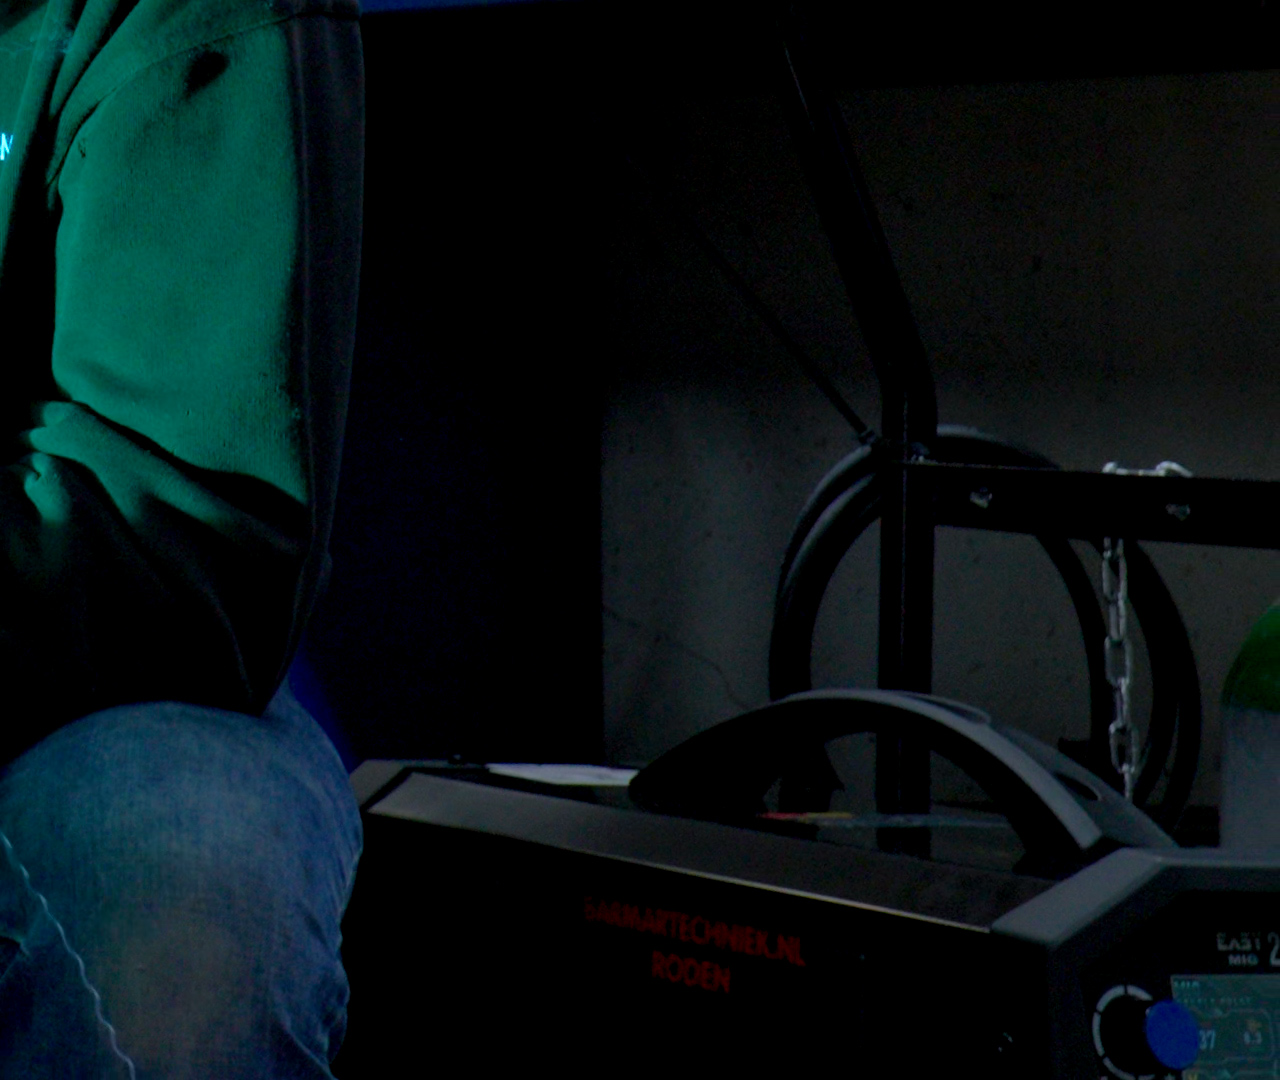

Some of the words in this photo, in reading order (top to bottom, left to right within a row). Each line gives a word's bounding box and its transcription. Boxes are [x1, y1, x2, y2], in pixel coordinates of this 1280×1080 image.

[583, 895, 807, 967] BARMARTECHNIEK.NL
[651, 949, 731, 994] RODEN
[1227, 953, 1259, 966] MIG
